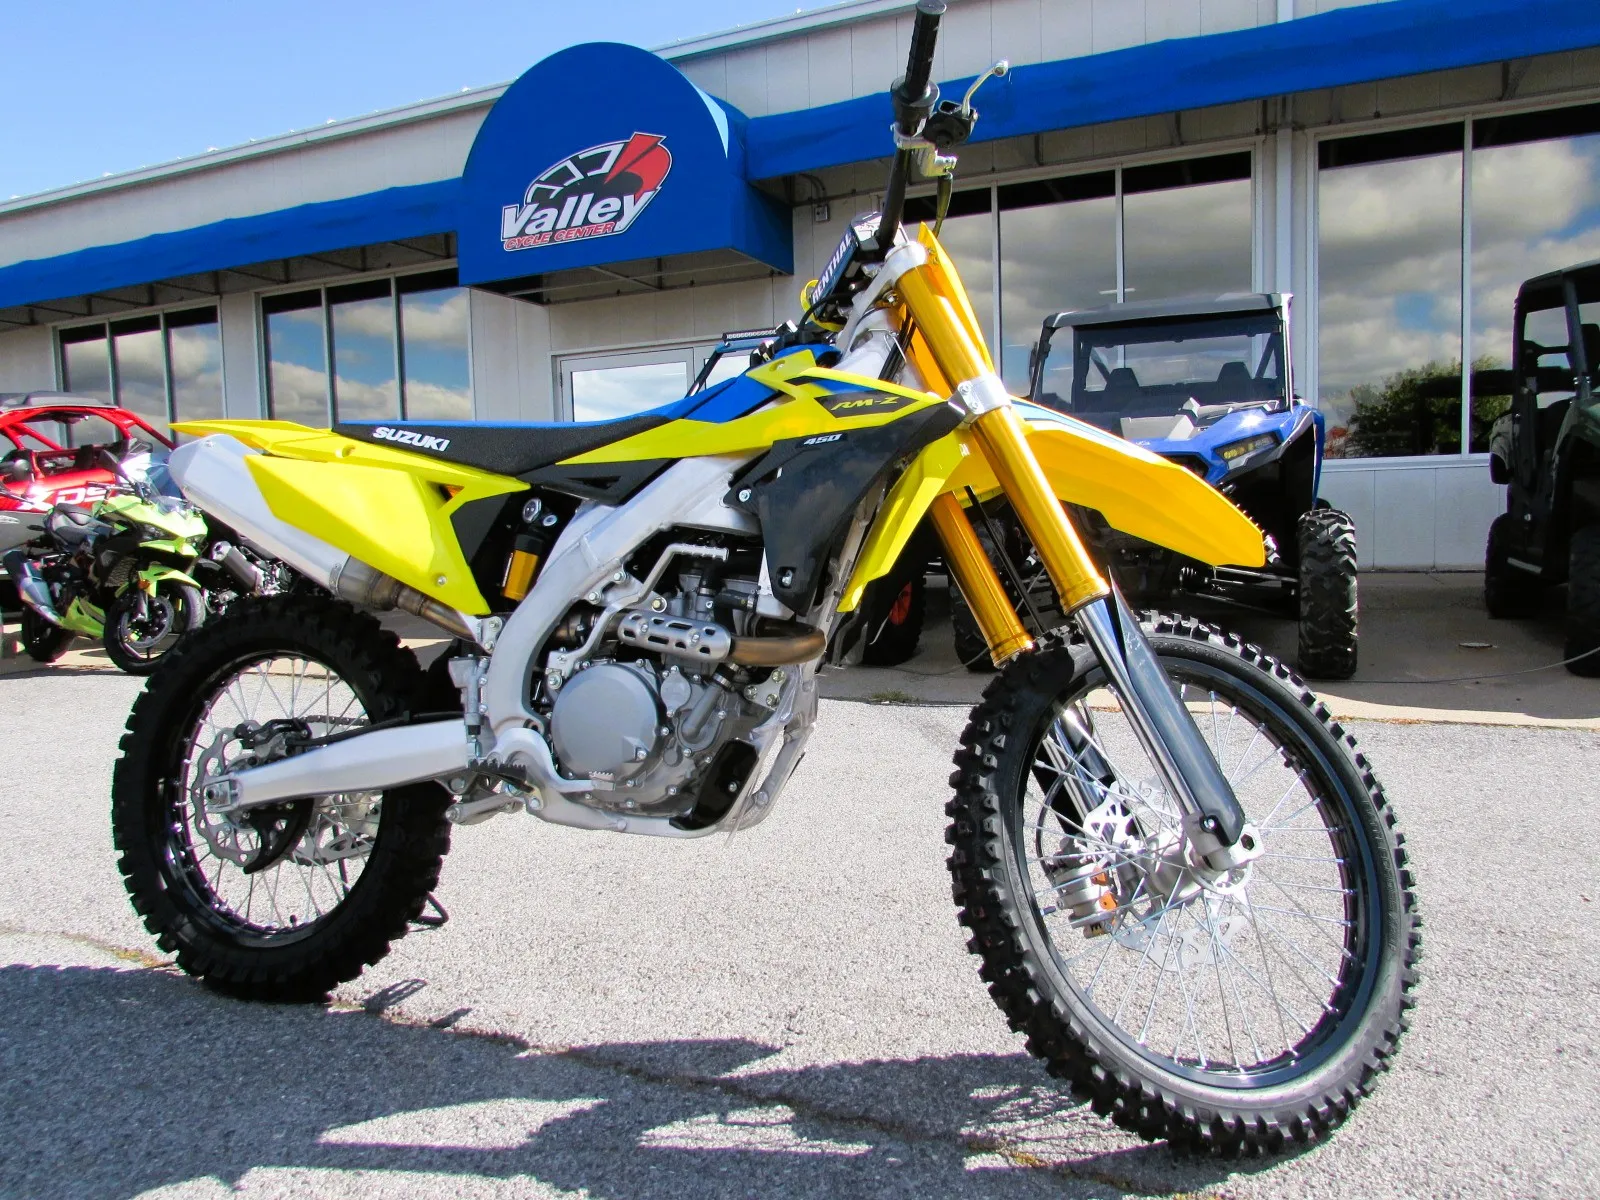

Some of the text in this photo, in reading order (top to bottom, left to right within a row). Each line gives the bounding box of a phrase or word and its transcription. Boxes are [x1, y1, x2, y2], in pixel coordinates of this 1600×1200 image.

[503, 190, 655, 239] Valley
[505, 222, 615, 249] CYCLE CENTER
[811, 233, 852, 304] RENTHAL
[830, 397, 899, 411] RM-Z
[372, 426, 451, 452] SUZUKI
[803, 433, 843, 446] 450
